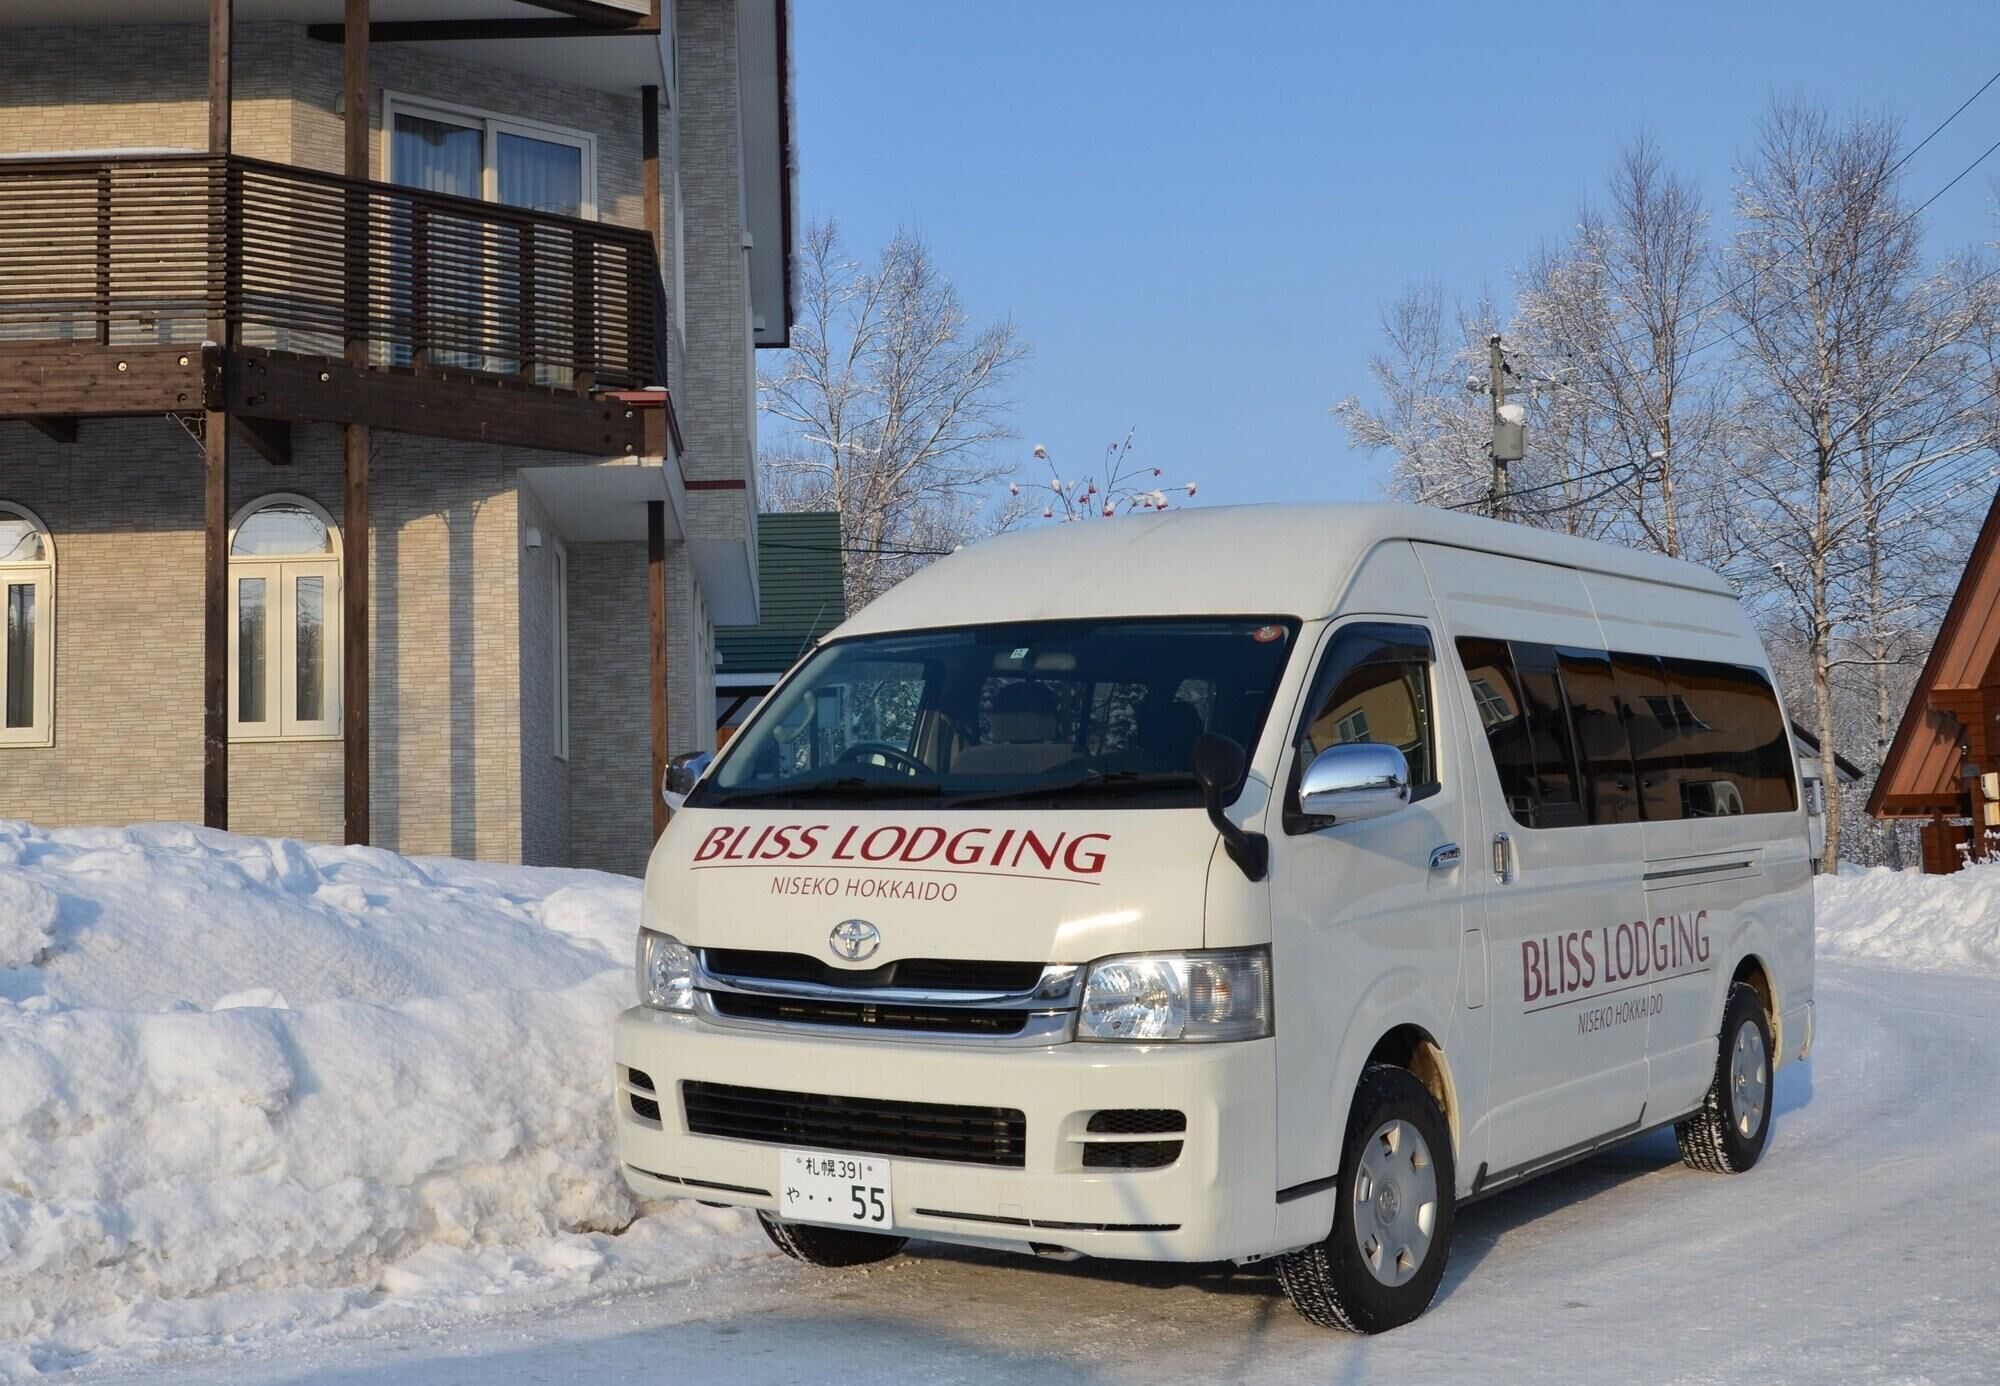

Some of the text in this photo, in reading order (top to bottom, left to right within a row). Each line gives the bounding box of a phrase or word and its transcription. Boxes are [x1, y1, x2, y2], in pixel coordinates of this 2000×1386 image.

[694, 825, 1112, 873] BLISS LODGING
[770, 876, 958, 903] NISEKO HOKKAIDO
[1522, 910, 1710, 1002] BLISS LODGING
[1578, 994, 1663, 1035] NISEKO HOKKAIDO
